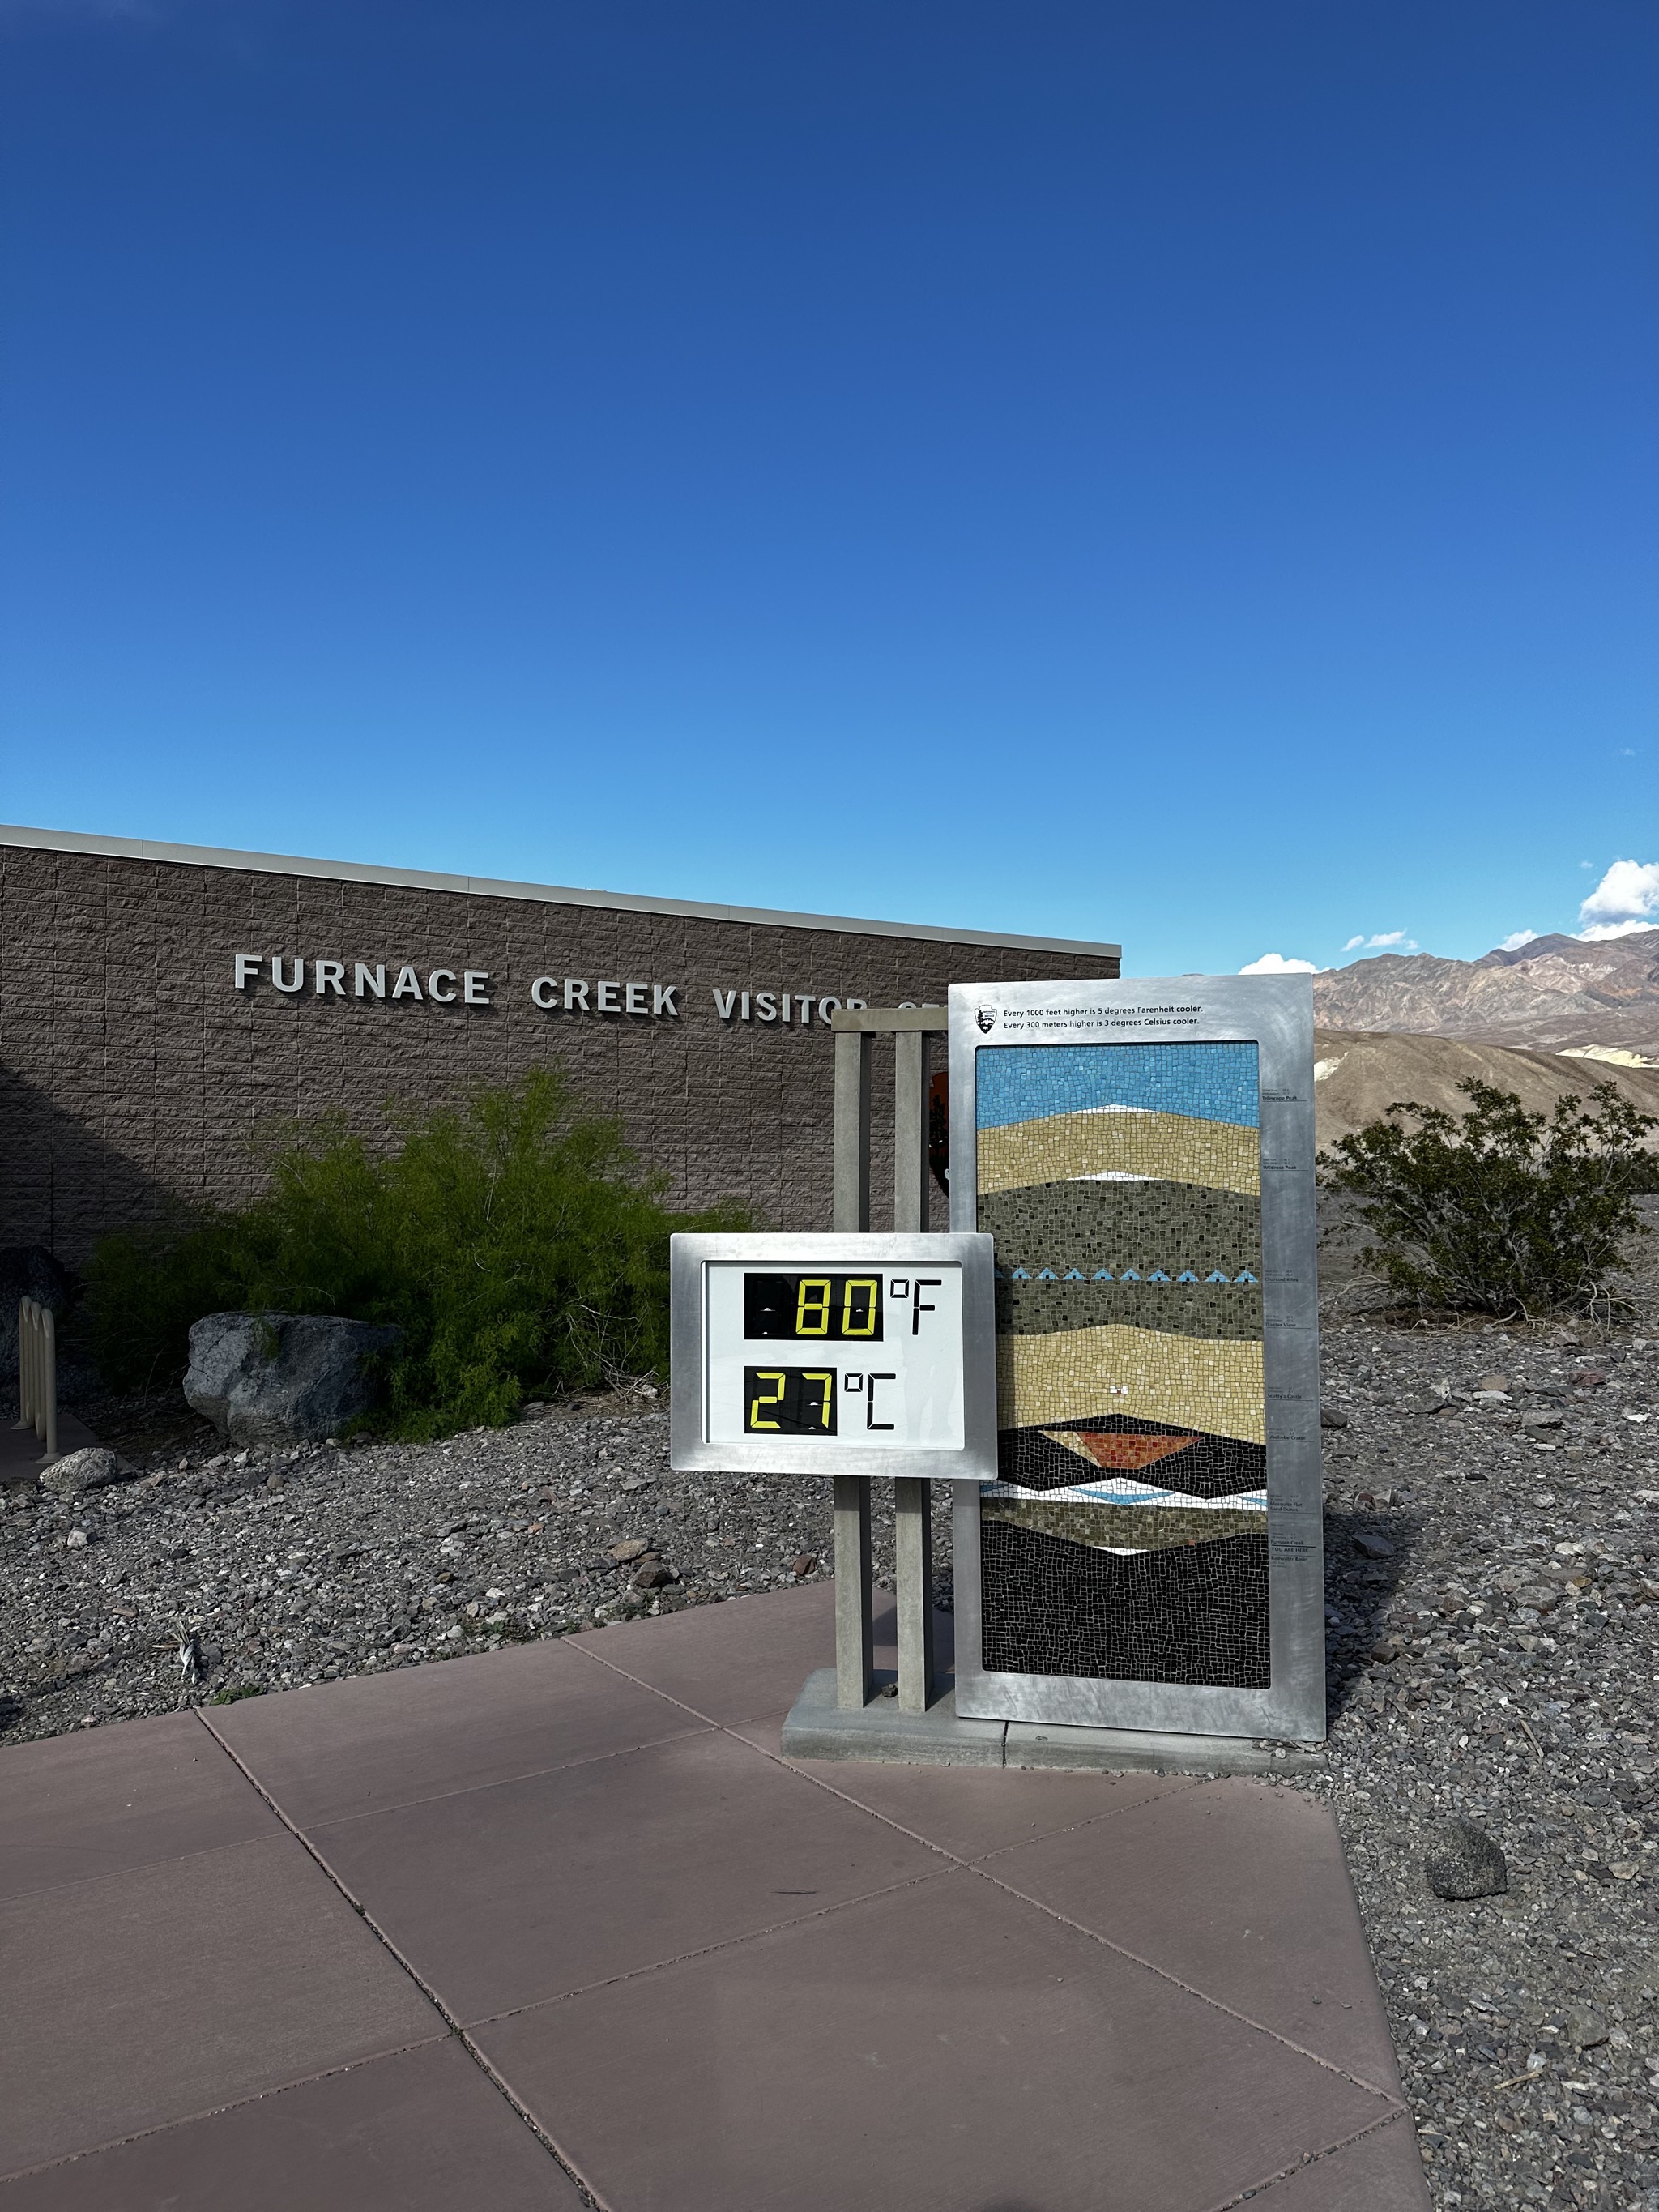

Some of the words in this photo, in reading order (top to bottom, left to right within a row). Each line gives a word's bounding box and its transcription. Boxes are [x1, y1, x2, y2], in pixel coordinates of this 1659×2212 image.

[235, 954, 489, 1004] FURNACE
[531, 976, 679, 1016] CREEK
[1003, 1010, 1024, 1018] Every
[1063, 1008, 1088, 1016] higher
[1104, 1007, 1135, 1015] degrees
[1176, 1005, 1203, 1013] cooler.
[1004, 1022, 1025, 1030] Every
[1069, 1020, 1094, 1028] higher
[1111, 1019, 1142, 1027] degrees
[795, 1279, 877, 1335] 80
[750, 1372, 832, 1428] 27
